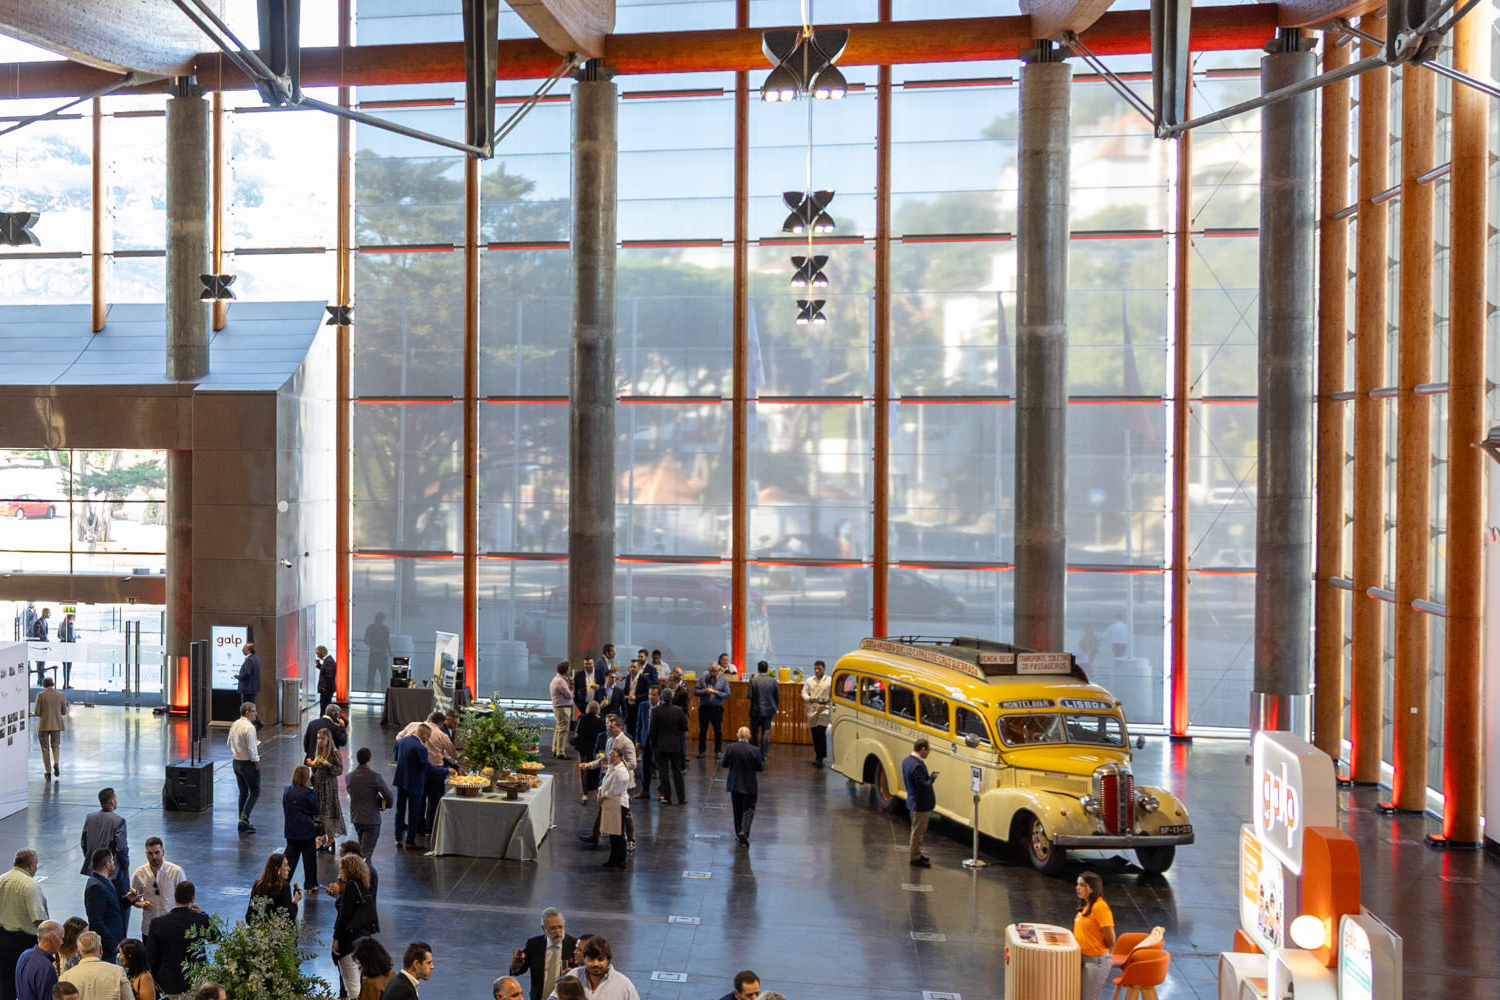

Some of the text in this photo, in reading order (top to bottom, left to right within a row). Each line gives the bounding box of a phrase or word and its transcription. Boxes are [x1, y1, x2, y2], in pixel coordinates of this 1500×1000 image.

[217, 634, 242, 647] galp
[1065, 700, 1107, 709] LISBOA
[1264, 762, 1299, 848] galp
